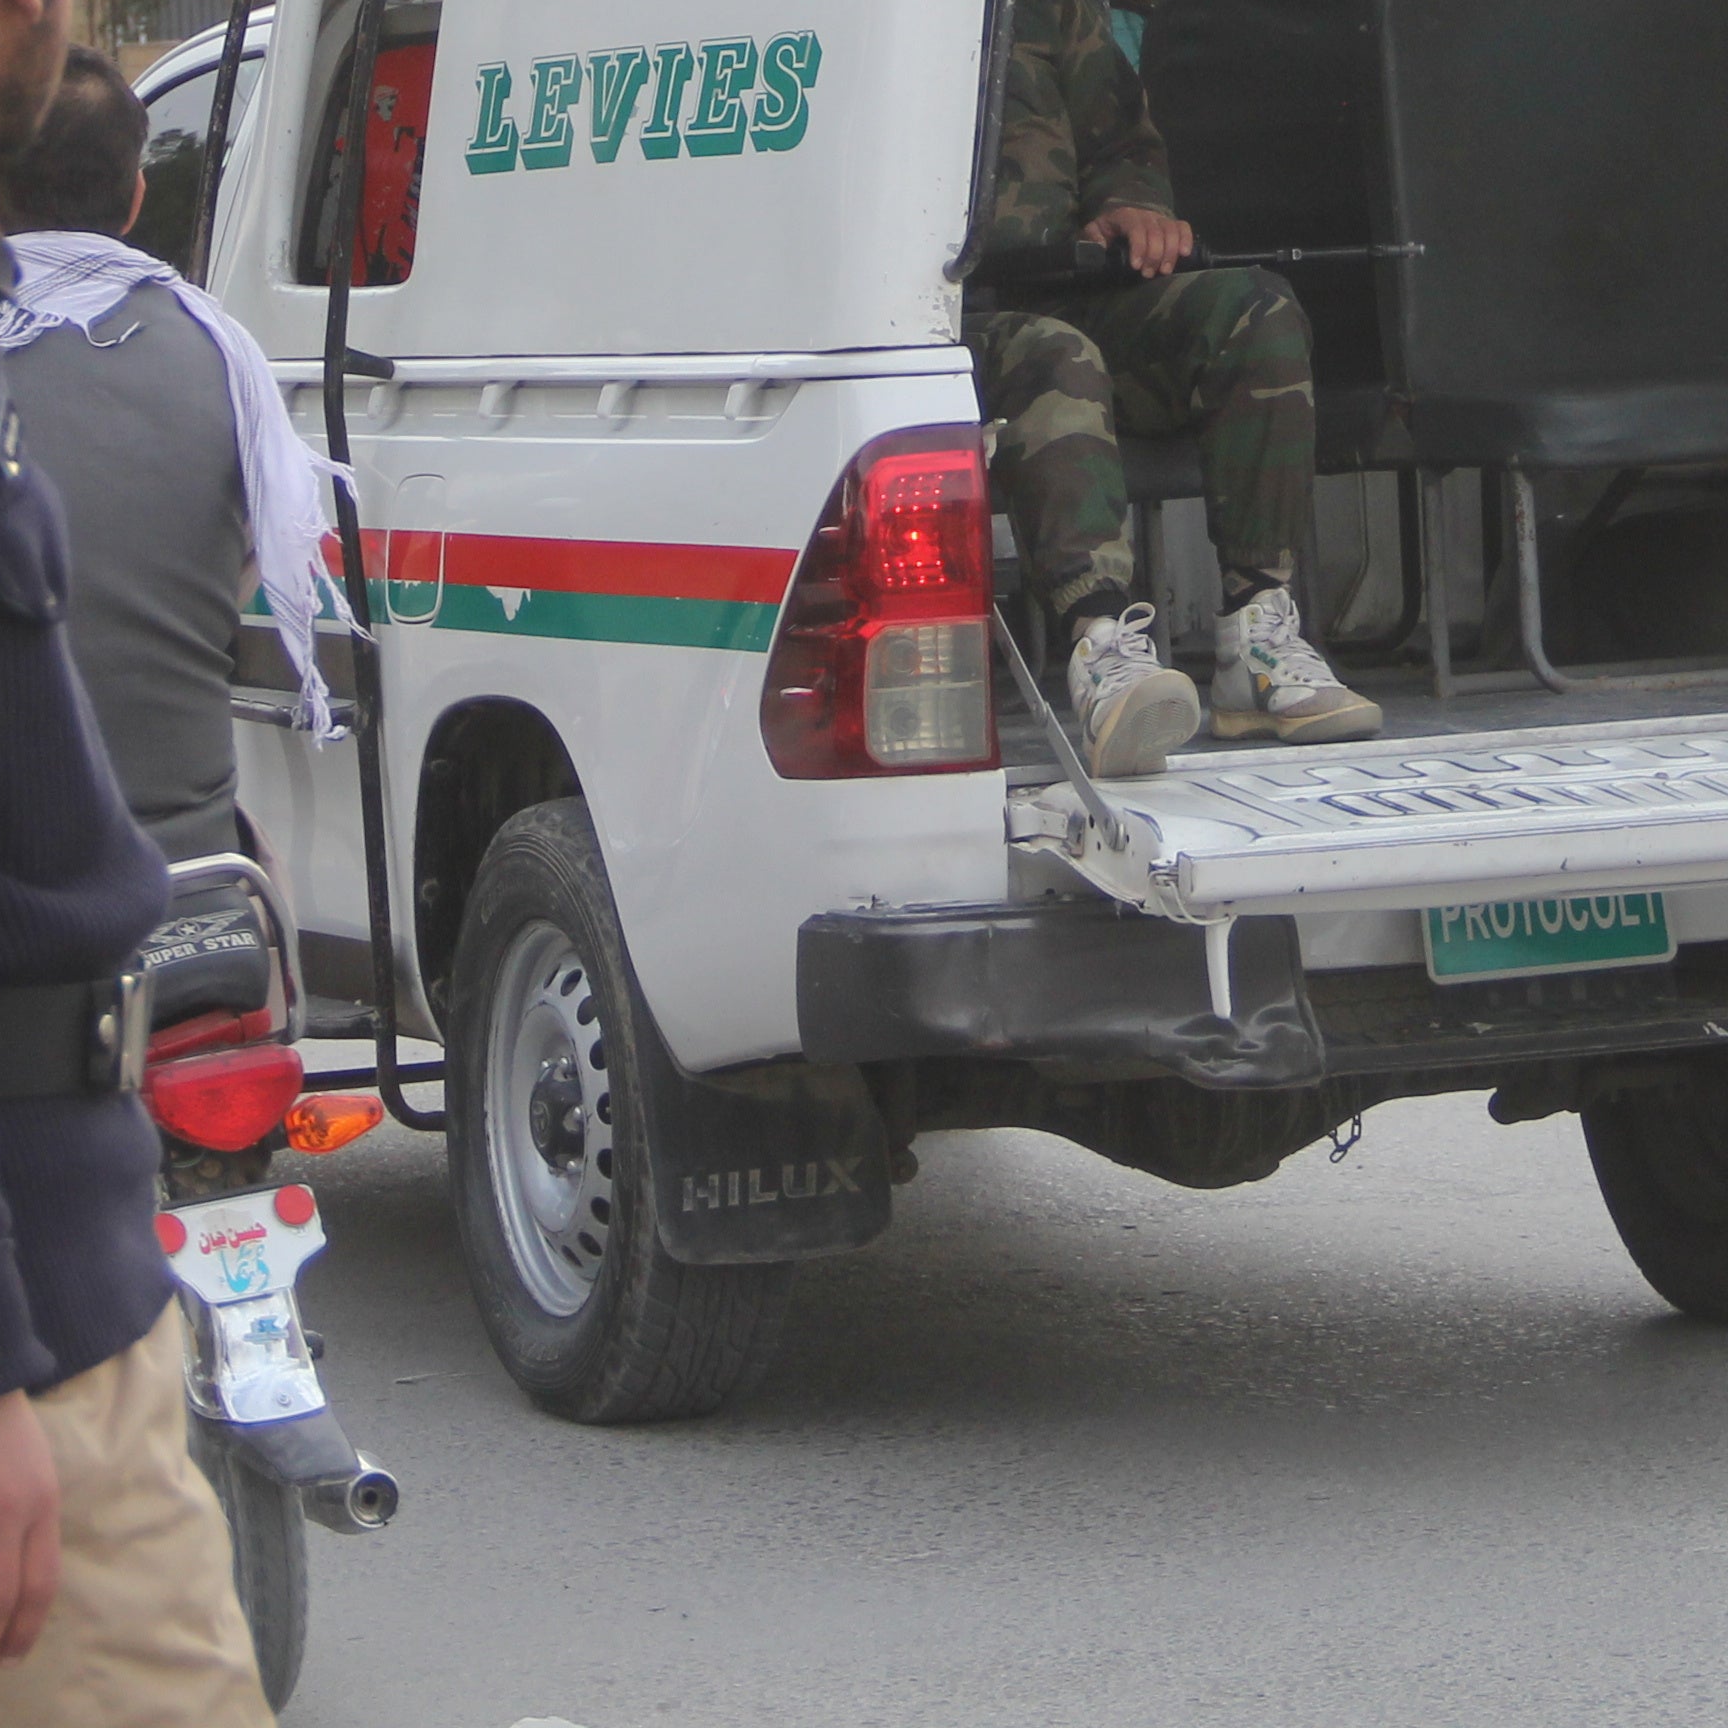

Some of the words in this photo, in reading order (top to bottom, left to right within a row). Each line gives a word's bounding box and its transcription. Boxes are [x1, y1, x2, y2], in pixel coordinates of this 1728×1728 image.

[464, 29, 823, 175] LEVIES
[202, 931, 257, 951] STAR
[681, 1156, 864, 1212] HILUX
